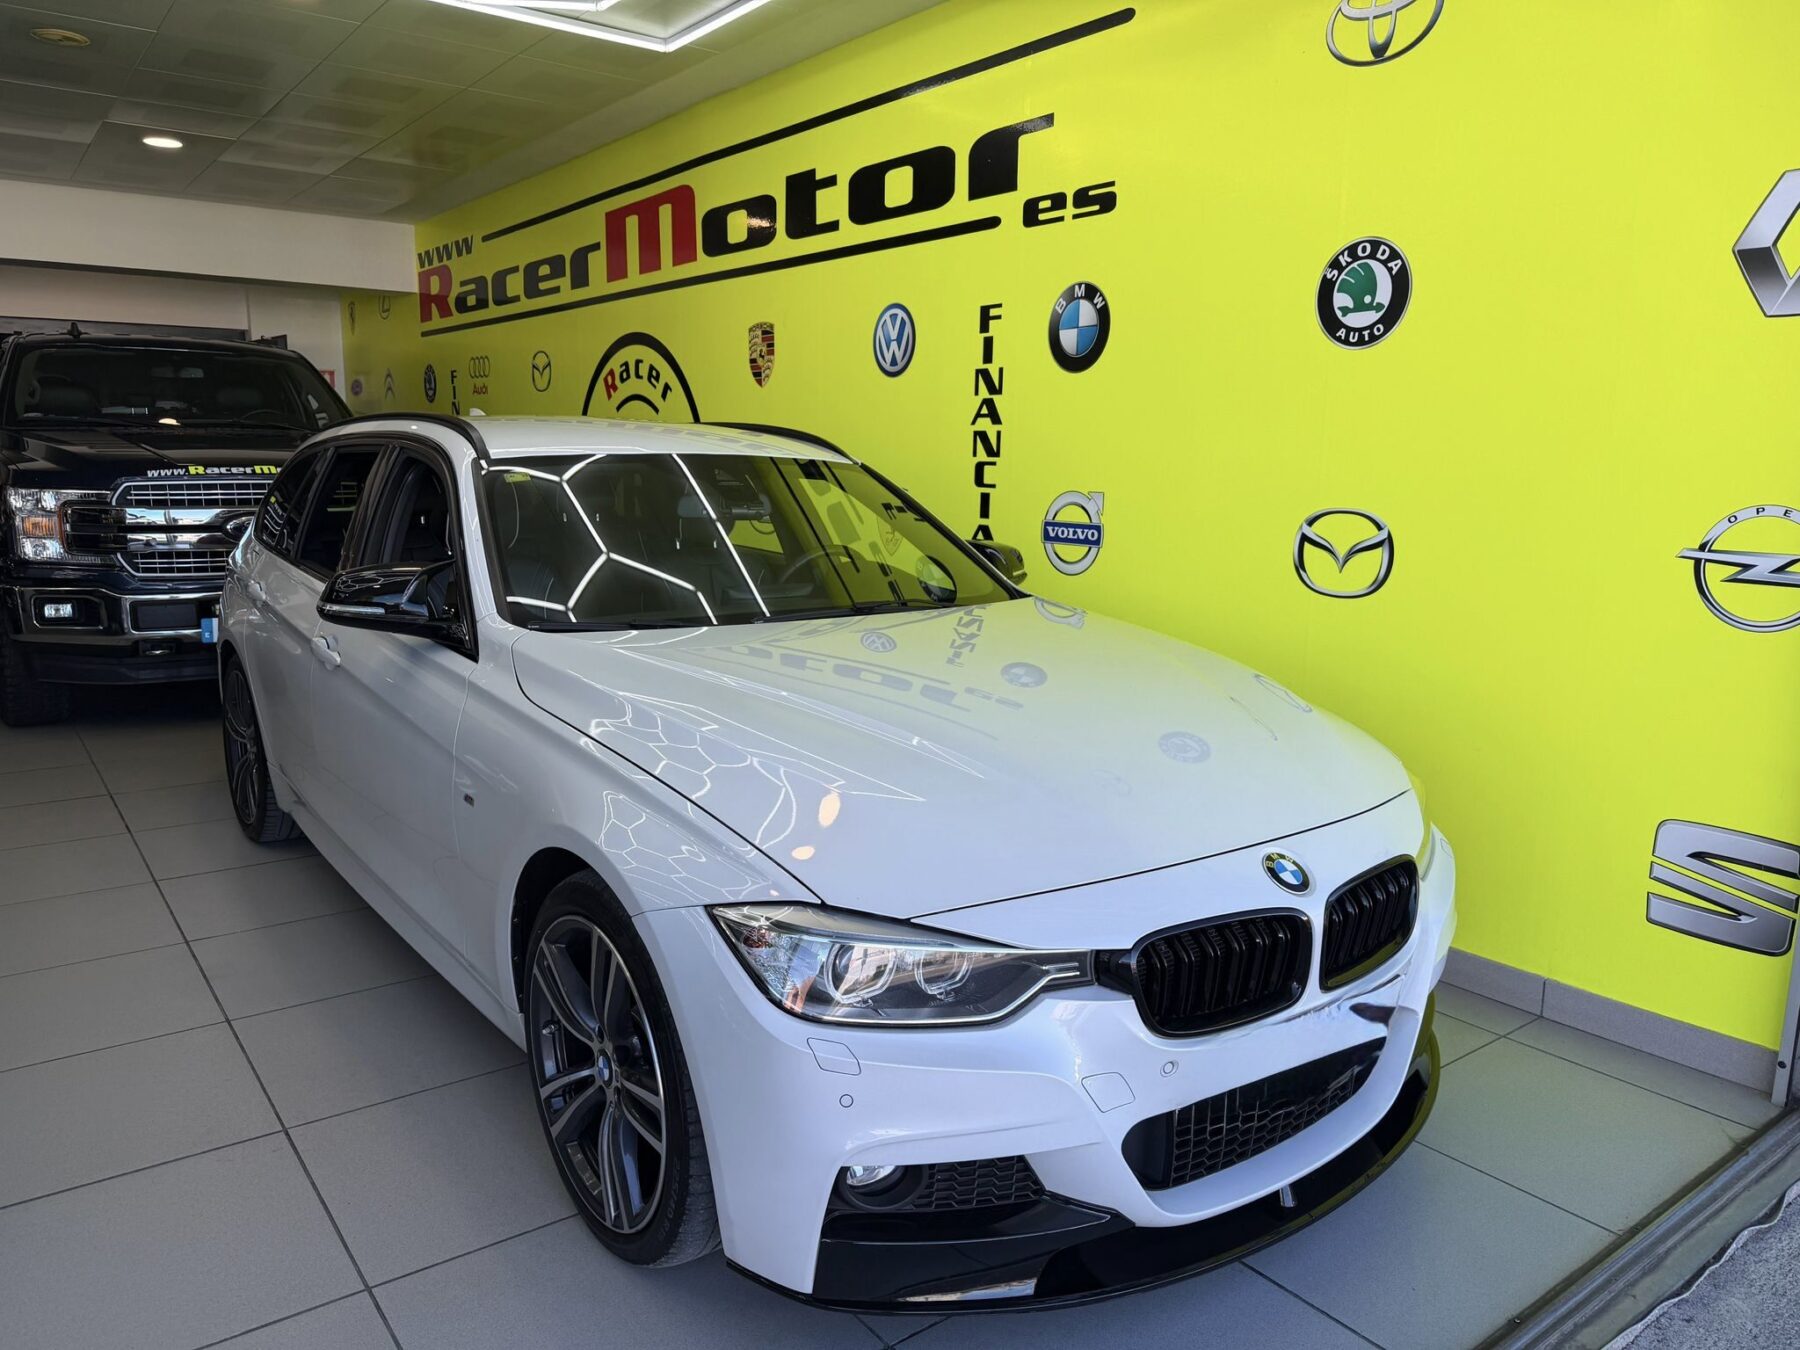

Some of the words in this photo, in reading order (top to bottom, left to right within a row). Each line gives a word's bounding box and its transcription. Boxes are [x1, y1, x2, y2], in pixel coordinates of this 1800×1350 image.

[418, 112, 1055, 324] RacerMotor
[1022, 180, 1117, 229] es
[416, 234, 474, 269] www
[1055, 283, 1106, 314] BMW
[1336, 324, 1384, 343] AUTO
[472, 383, 489, 396] Audi
[603, 358, 672, 402] Racer
[1046, 526, 1099, 541] VOLVO
